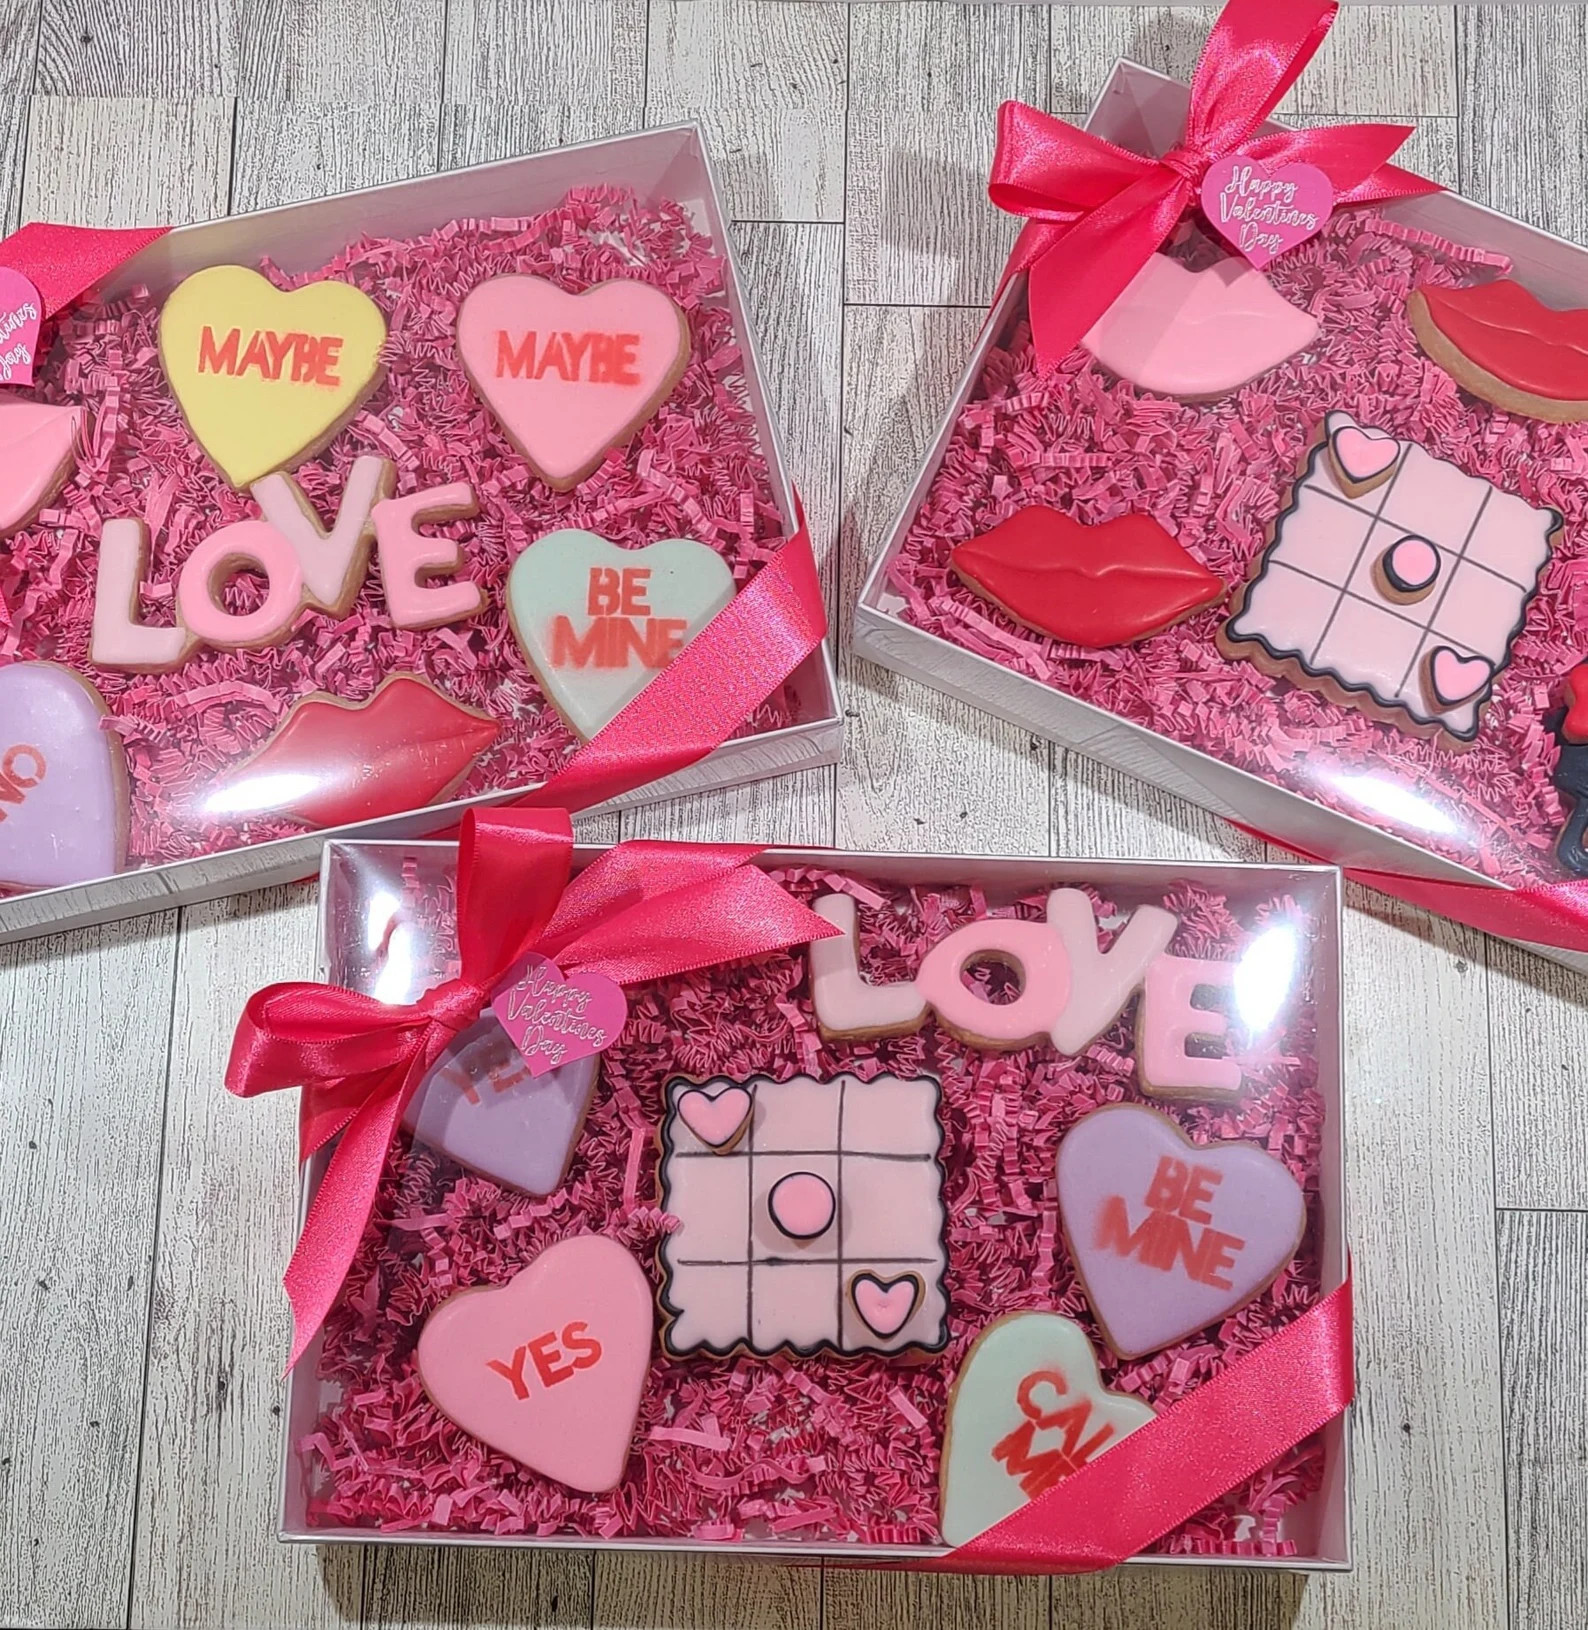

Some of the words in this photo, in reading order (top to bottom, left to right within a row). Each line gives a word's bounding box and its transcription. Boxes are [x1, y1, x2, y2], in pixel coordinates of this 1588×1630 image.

[1219, 192, 1320, 230] Valentines
[1225, 166, 1298, 203] Happy
[1239, 221, 1283, 254] Day
[199, 326, 344, 387] MAYBE
[495, 330, 643, 388] MAYBE
[93, 456, 485, 670] LOVE
[588, 567, 652, 616] BE
[551, 615, 688, 670] MINE
[508, 987, 608, 1048] Valentines
[517, 965, 592, 1013] Happy
[810, 888, 1246, 1096] LOVE
[521, 1024, 568, 1065] Day
[1144, 1154, 1223, 1226] BE
[1095, 1194, 1245, 1291] MINE
[486, 1321, 602, 1400] YES
